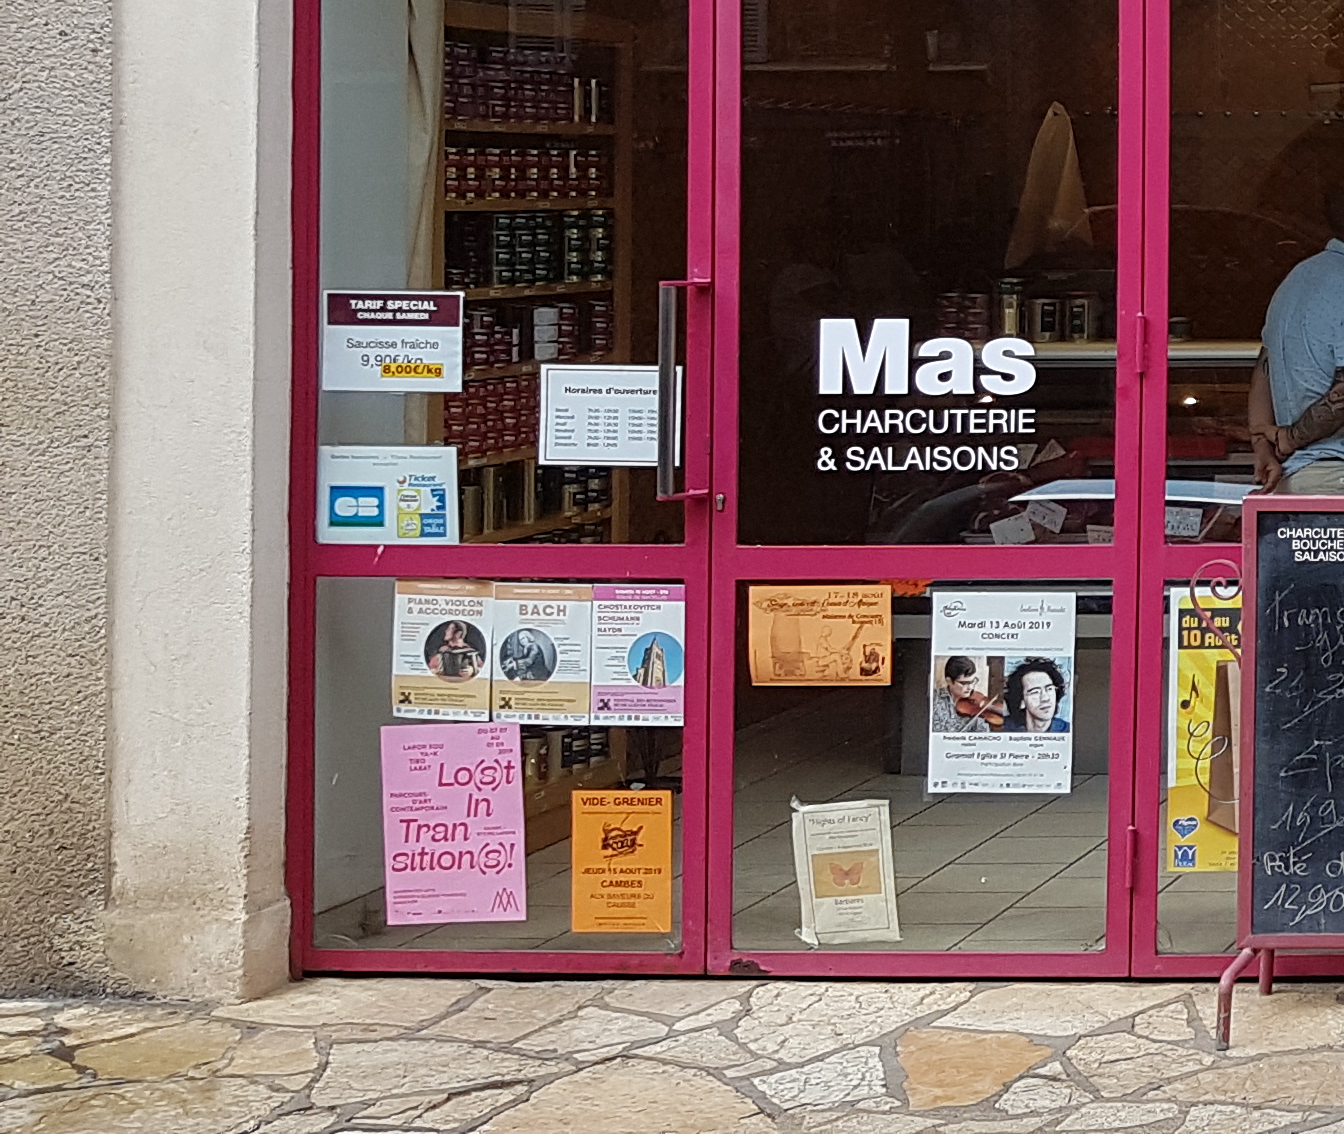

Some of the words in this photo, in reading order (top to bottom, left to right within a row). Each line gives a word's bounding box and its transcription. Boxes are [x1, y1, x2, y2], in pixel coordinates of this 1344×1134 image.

[350, 300, 384, 310] TARIF
[387, 300, 438, 311] SPECIAL
[346, 338, 398, 350] Saucisse
[819, 318, 1037, 396] Mas
[382, 364, 443, 378] 8,00€/kg
[818, 409, 1037, 435] CHARCUTERIE
[817, 446, 837, 471] &
[845, 446, 1019, 471] SALAISONS
[443, 598, 484, 607] VIOLON
[597, 603, 662, 611] CHOSTAKOVITCH
[519, 604, 567, 616] BACH
[957, 620, 986, 629] Mardi
[989, 620, 1000, 629] 13
[1028, 621, 1052, 630] 2019
[1181, 615, 1199, 627] du
[1214, 616, 1230, 628] au
[1181, 629, 1202, 646] 10
[438, 758, 516, 793] Lo(s)t
[466, 793, 494, 818] In
[613, 797, 663, 807] GRENIER
[399, 818, 472, 843] Tran
[391, 842, 516, 876] sition(s)!
